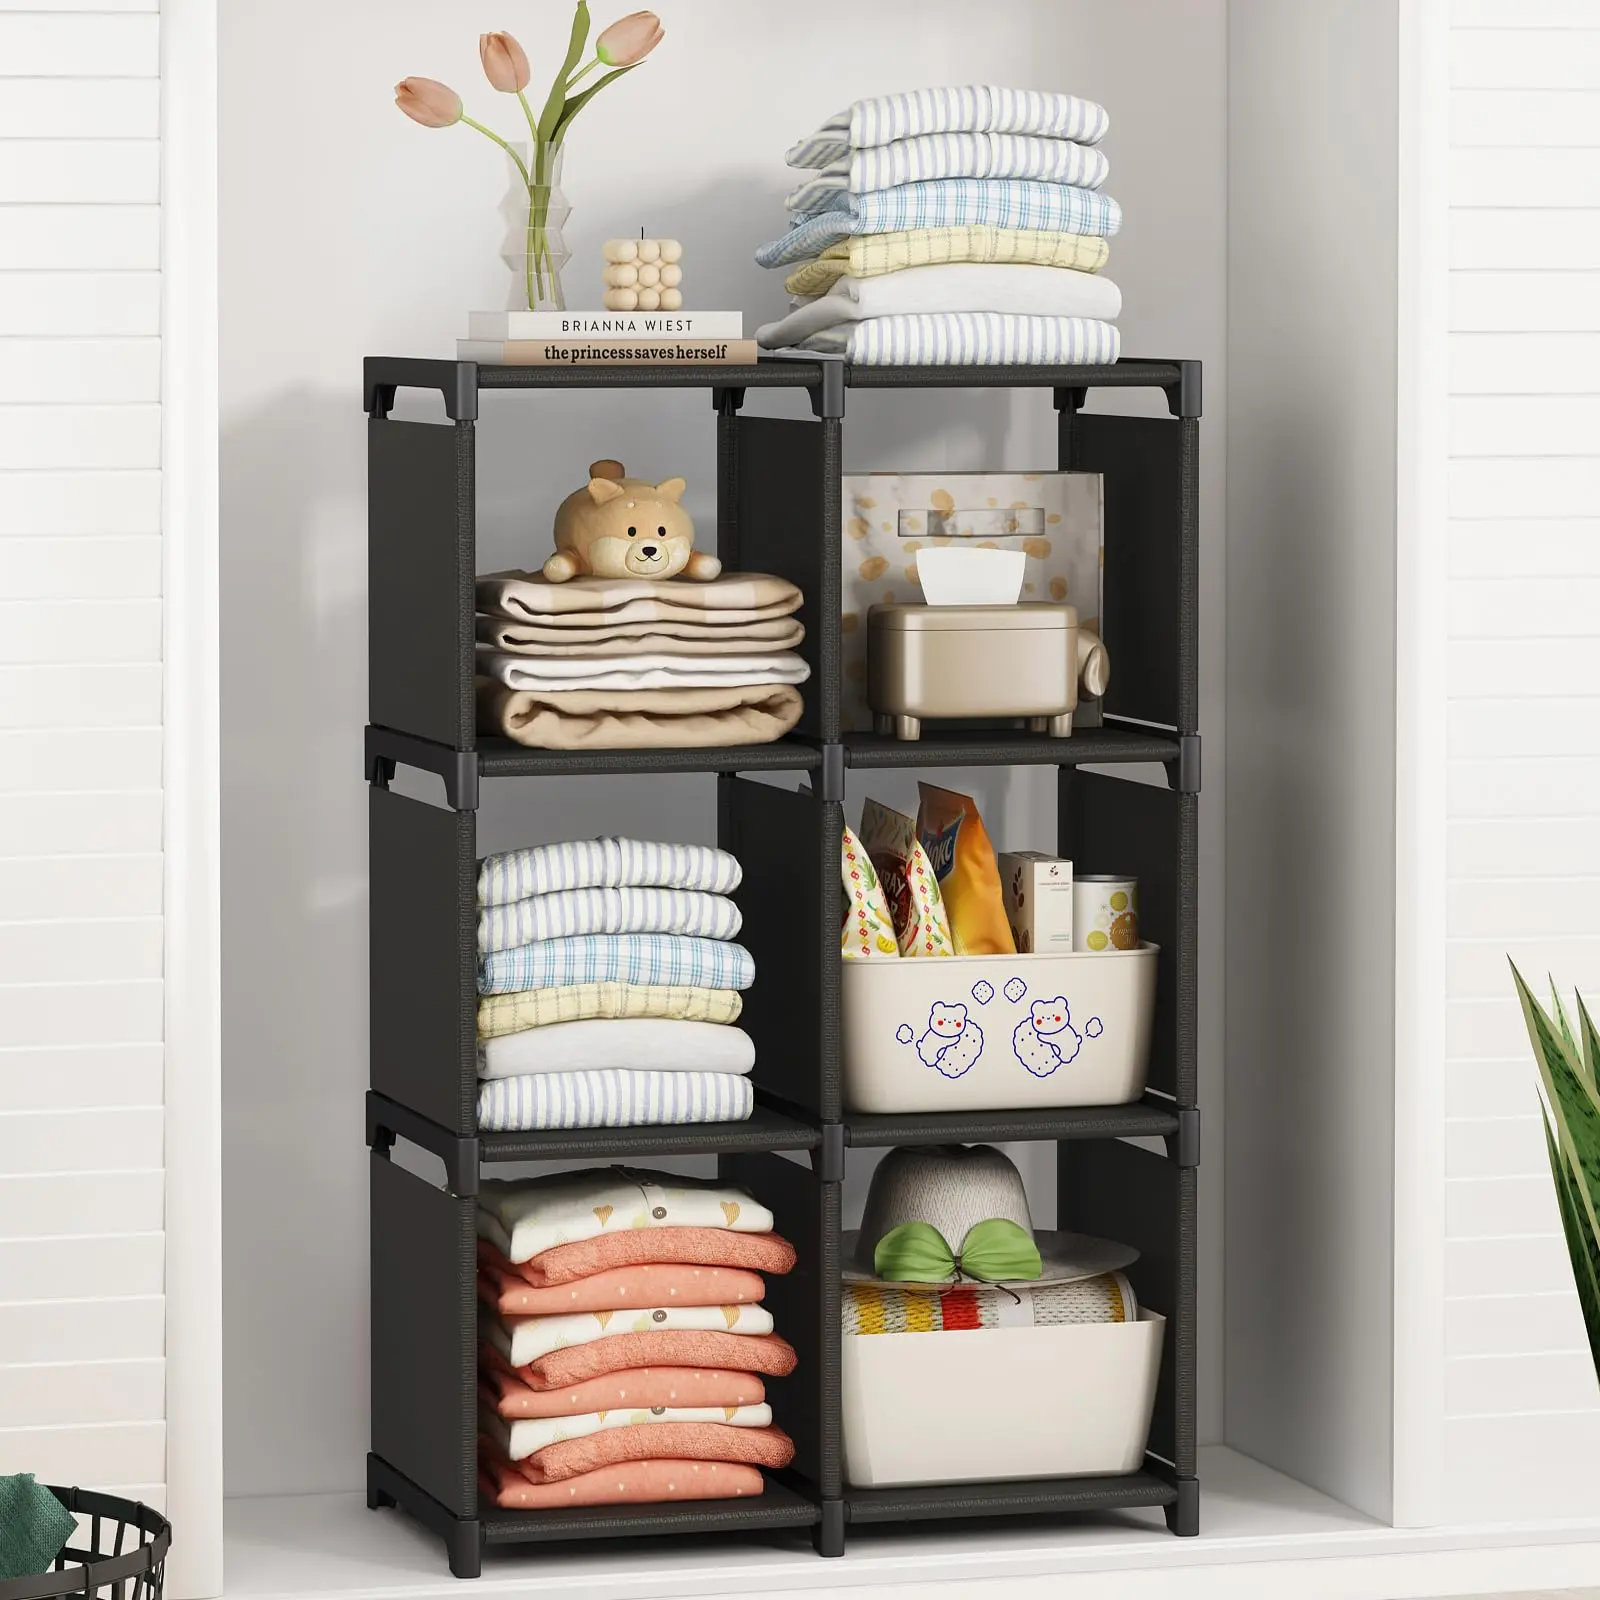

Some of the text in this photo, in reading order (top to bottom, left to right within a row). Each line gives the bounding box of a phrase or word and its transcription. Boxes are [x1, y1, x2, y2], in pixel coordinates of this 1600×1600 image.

[562, 320, 693, 332] BRIANNA WIEST
[544, 344, 728, 364] the princess saves herself
